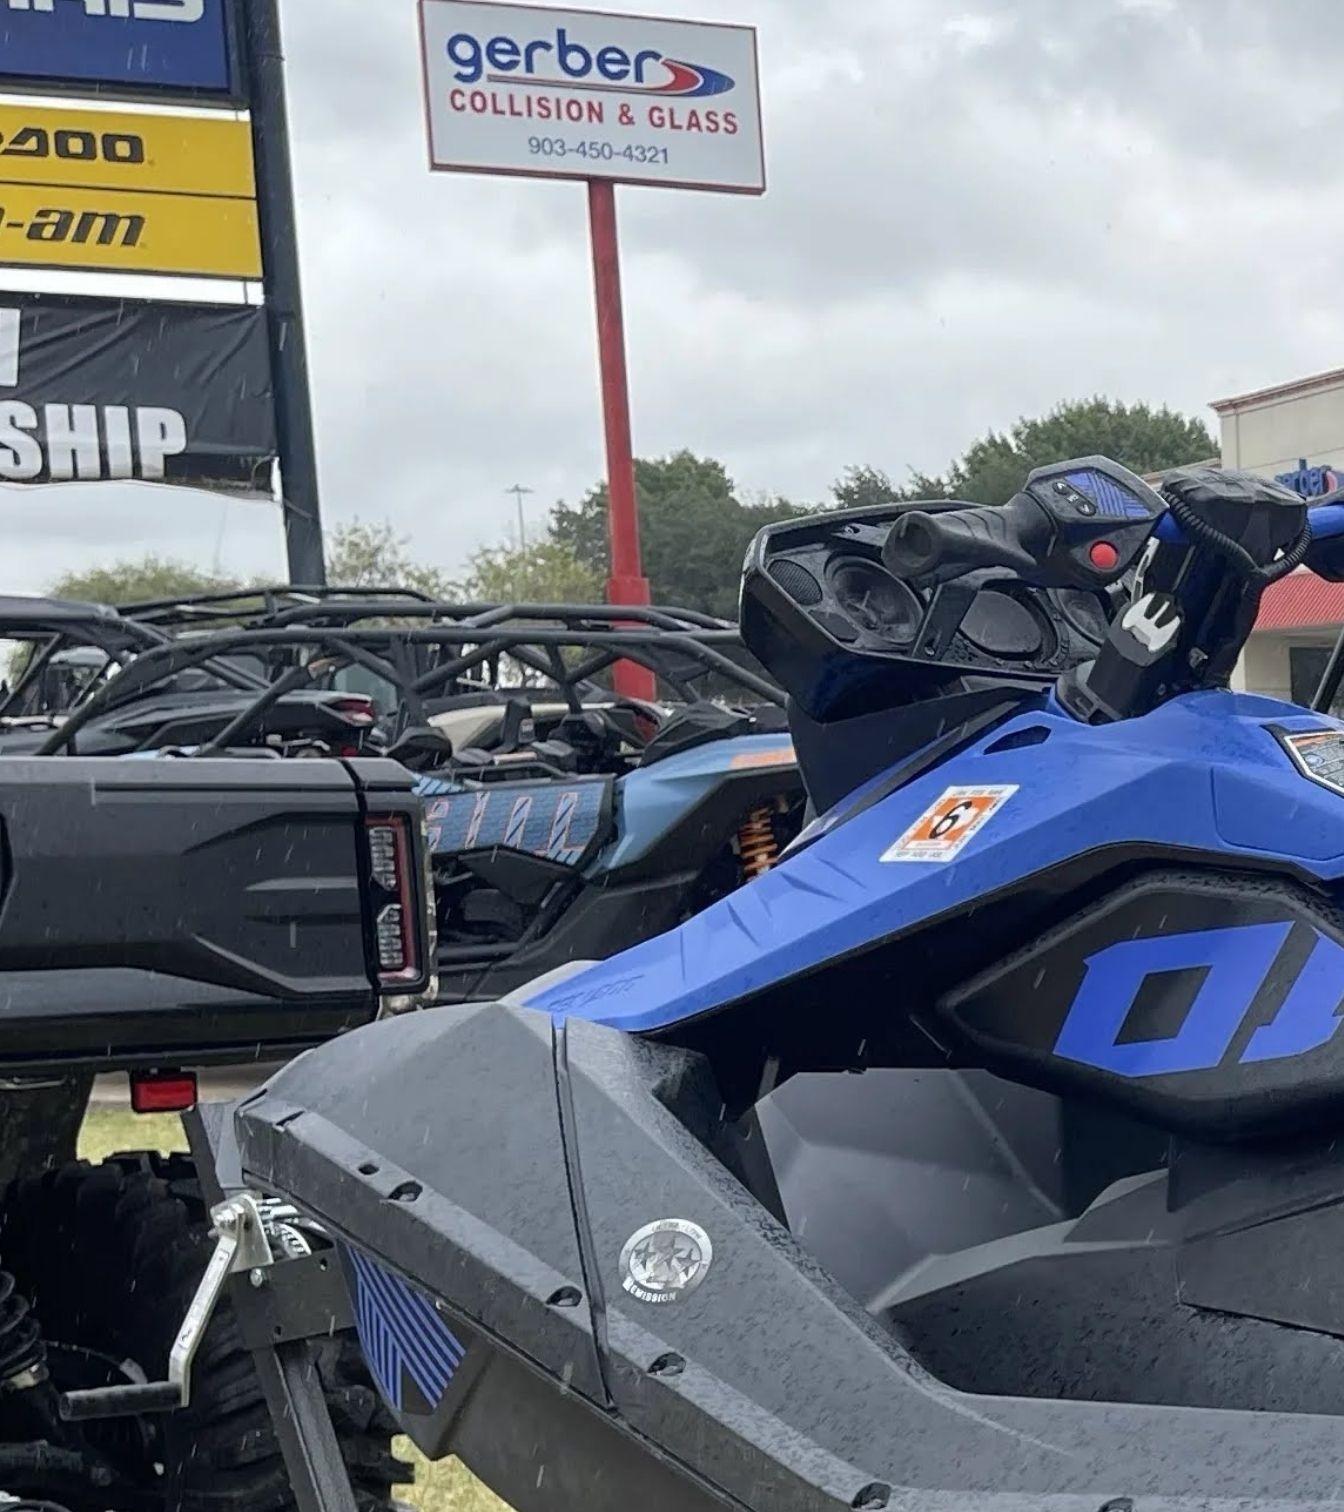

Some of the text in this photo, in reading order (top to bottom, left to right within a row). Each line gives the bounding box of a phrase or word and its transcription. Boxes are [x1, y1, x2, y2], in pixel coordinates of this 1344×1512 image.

[446, 28, 662, 83] gerber
[449, 88, 739, 134] COLLISION & GLASS
[528, 136, 669, 164] 903-450-4321
